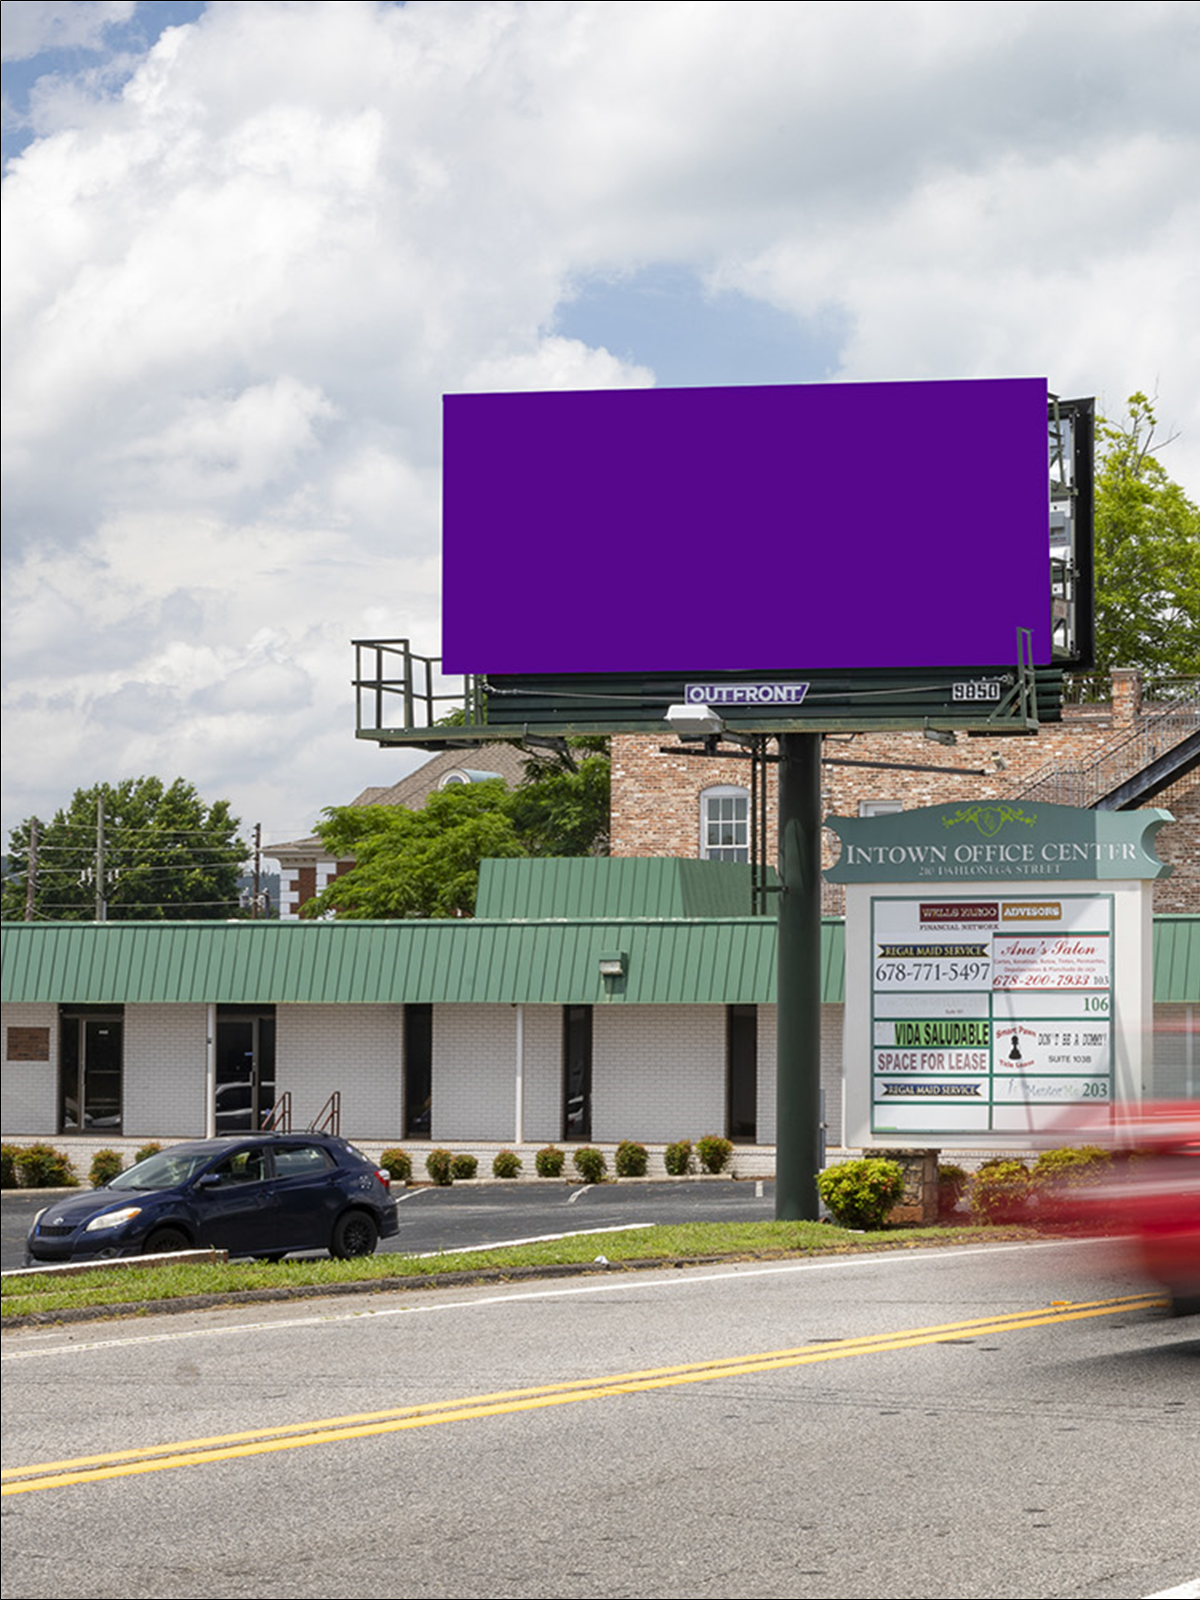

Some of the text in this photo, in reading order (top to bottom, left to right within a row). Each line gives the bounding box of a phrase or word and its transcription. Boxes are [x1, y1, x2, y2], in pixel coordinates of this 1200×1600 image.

[689, 685, 802, 702] OUTFRONT
[954, 684, 998, 699] 9850
[846, 842, 1137, 865] INTOWN OFFICE CENTER
[938, 864, 1012, 876] DAHLONEGA
[1016, 863, 1061, 874] STREET
[922, 907, 998, 918] WELLS FARGO
[1003, 906, 1060, 917] ADVISORS
[919, 923, 1000, 932] FINANCIAL NETWORK
[885, 946, 982, 956] REGAL MAID SERVICE
[1000, 940, 1096, 955] Ana's Salon
[876, 962, 991, 982] 678-771-5497
[992, 974, 1090, 986] 678-200-7933
[1083, 997, 1109, 1012] 106
[894, 1023, 989, 1046] VIDA SALUDABLE
[1019, 1025, 1037, 1037] Pawn
[1073, 1033, 1080, 1046] A
[877, 1053, 987, 1071] SPACE FOR LEASE
[1048, 1055, 1092, 1064] SUITE 103B
[888, 1086, 976, 1095] REGAL MAID SERVICE
[1082, 1082, 1108, 1098] 203
